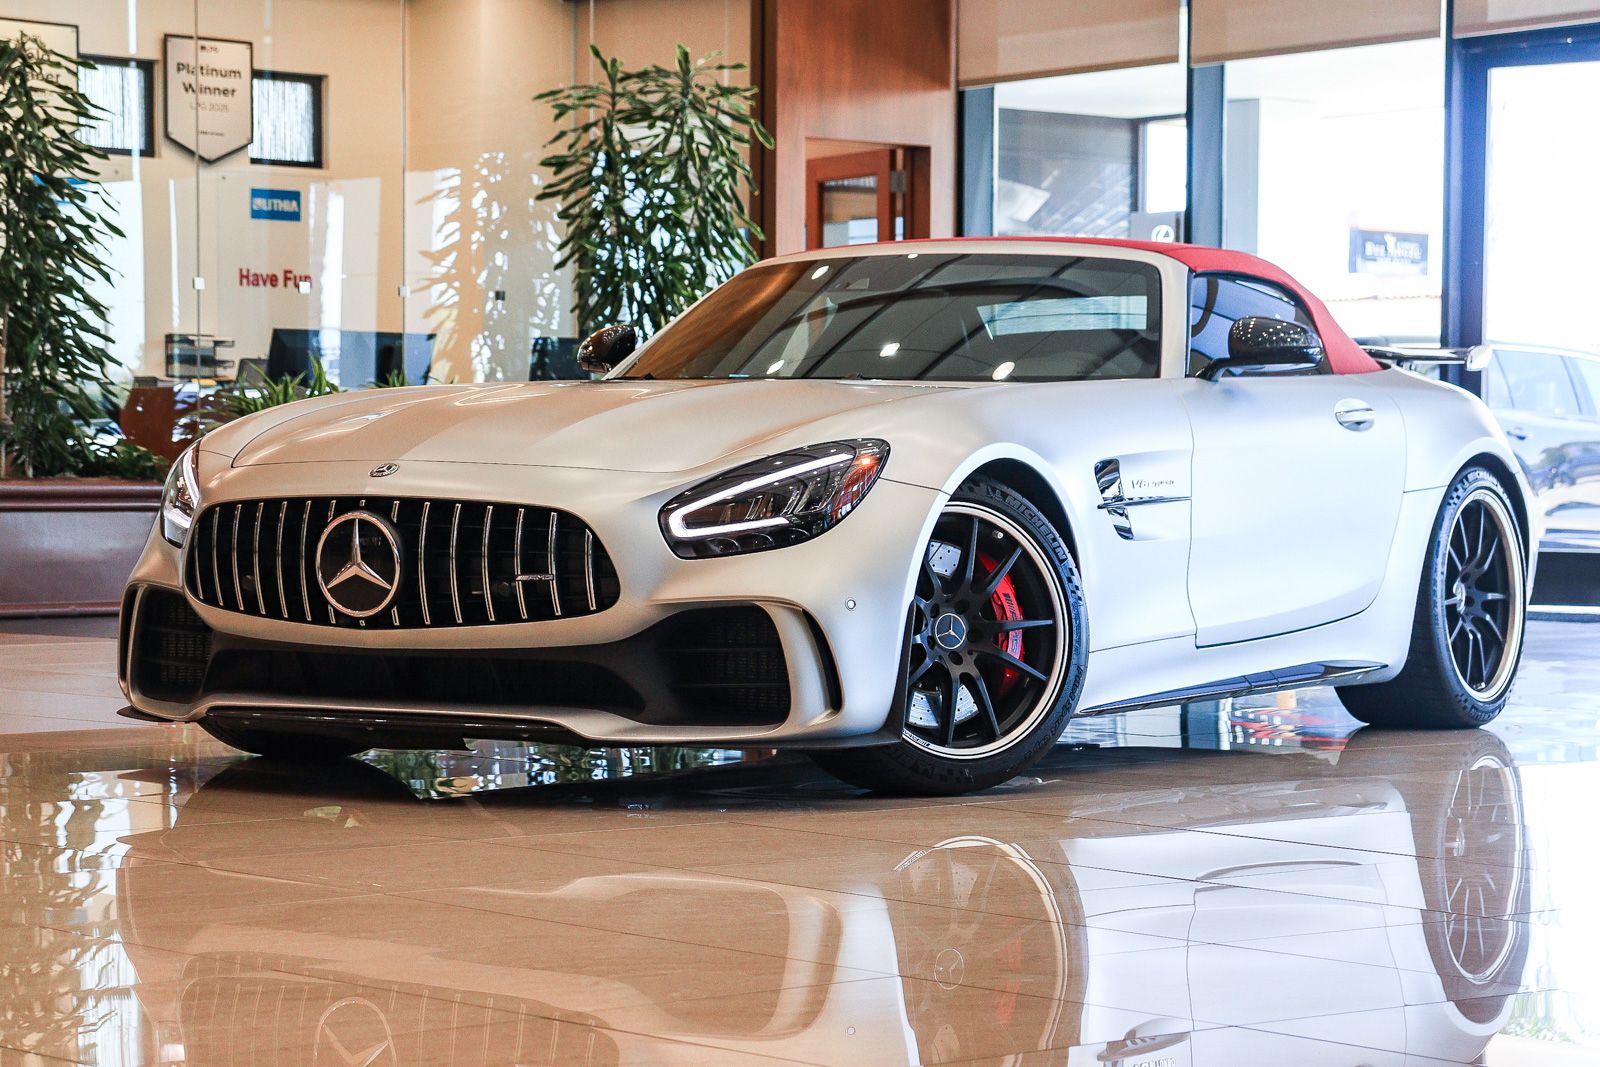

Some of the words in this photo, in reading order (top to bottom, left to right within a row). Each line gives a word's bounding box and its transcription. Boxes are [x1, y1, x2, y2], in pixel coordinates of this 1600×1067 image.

[176, 62, 242, 80] Platinum
[182, 81, 238, 98] Winner
[239, 268, 279, 288] Have
[1005, 495, 1068, 560] MICHELIN
